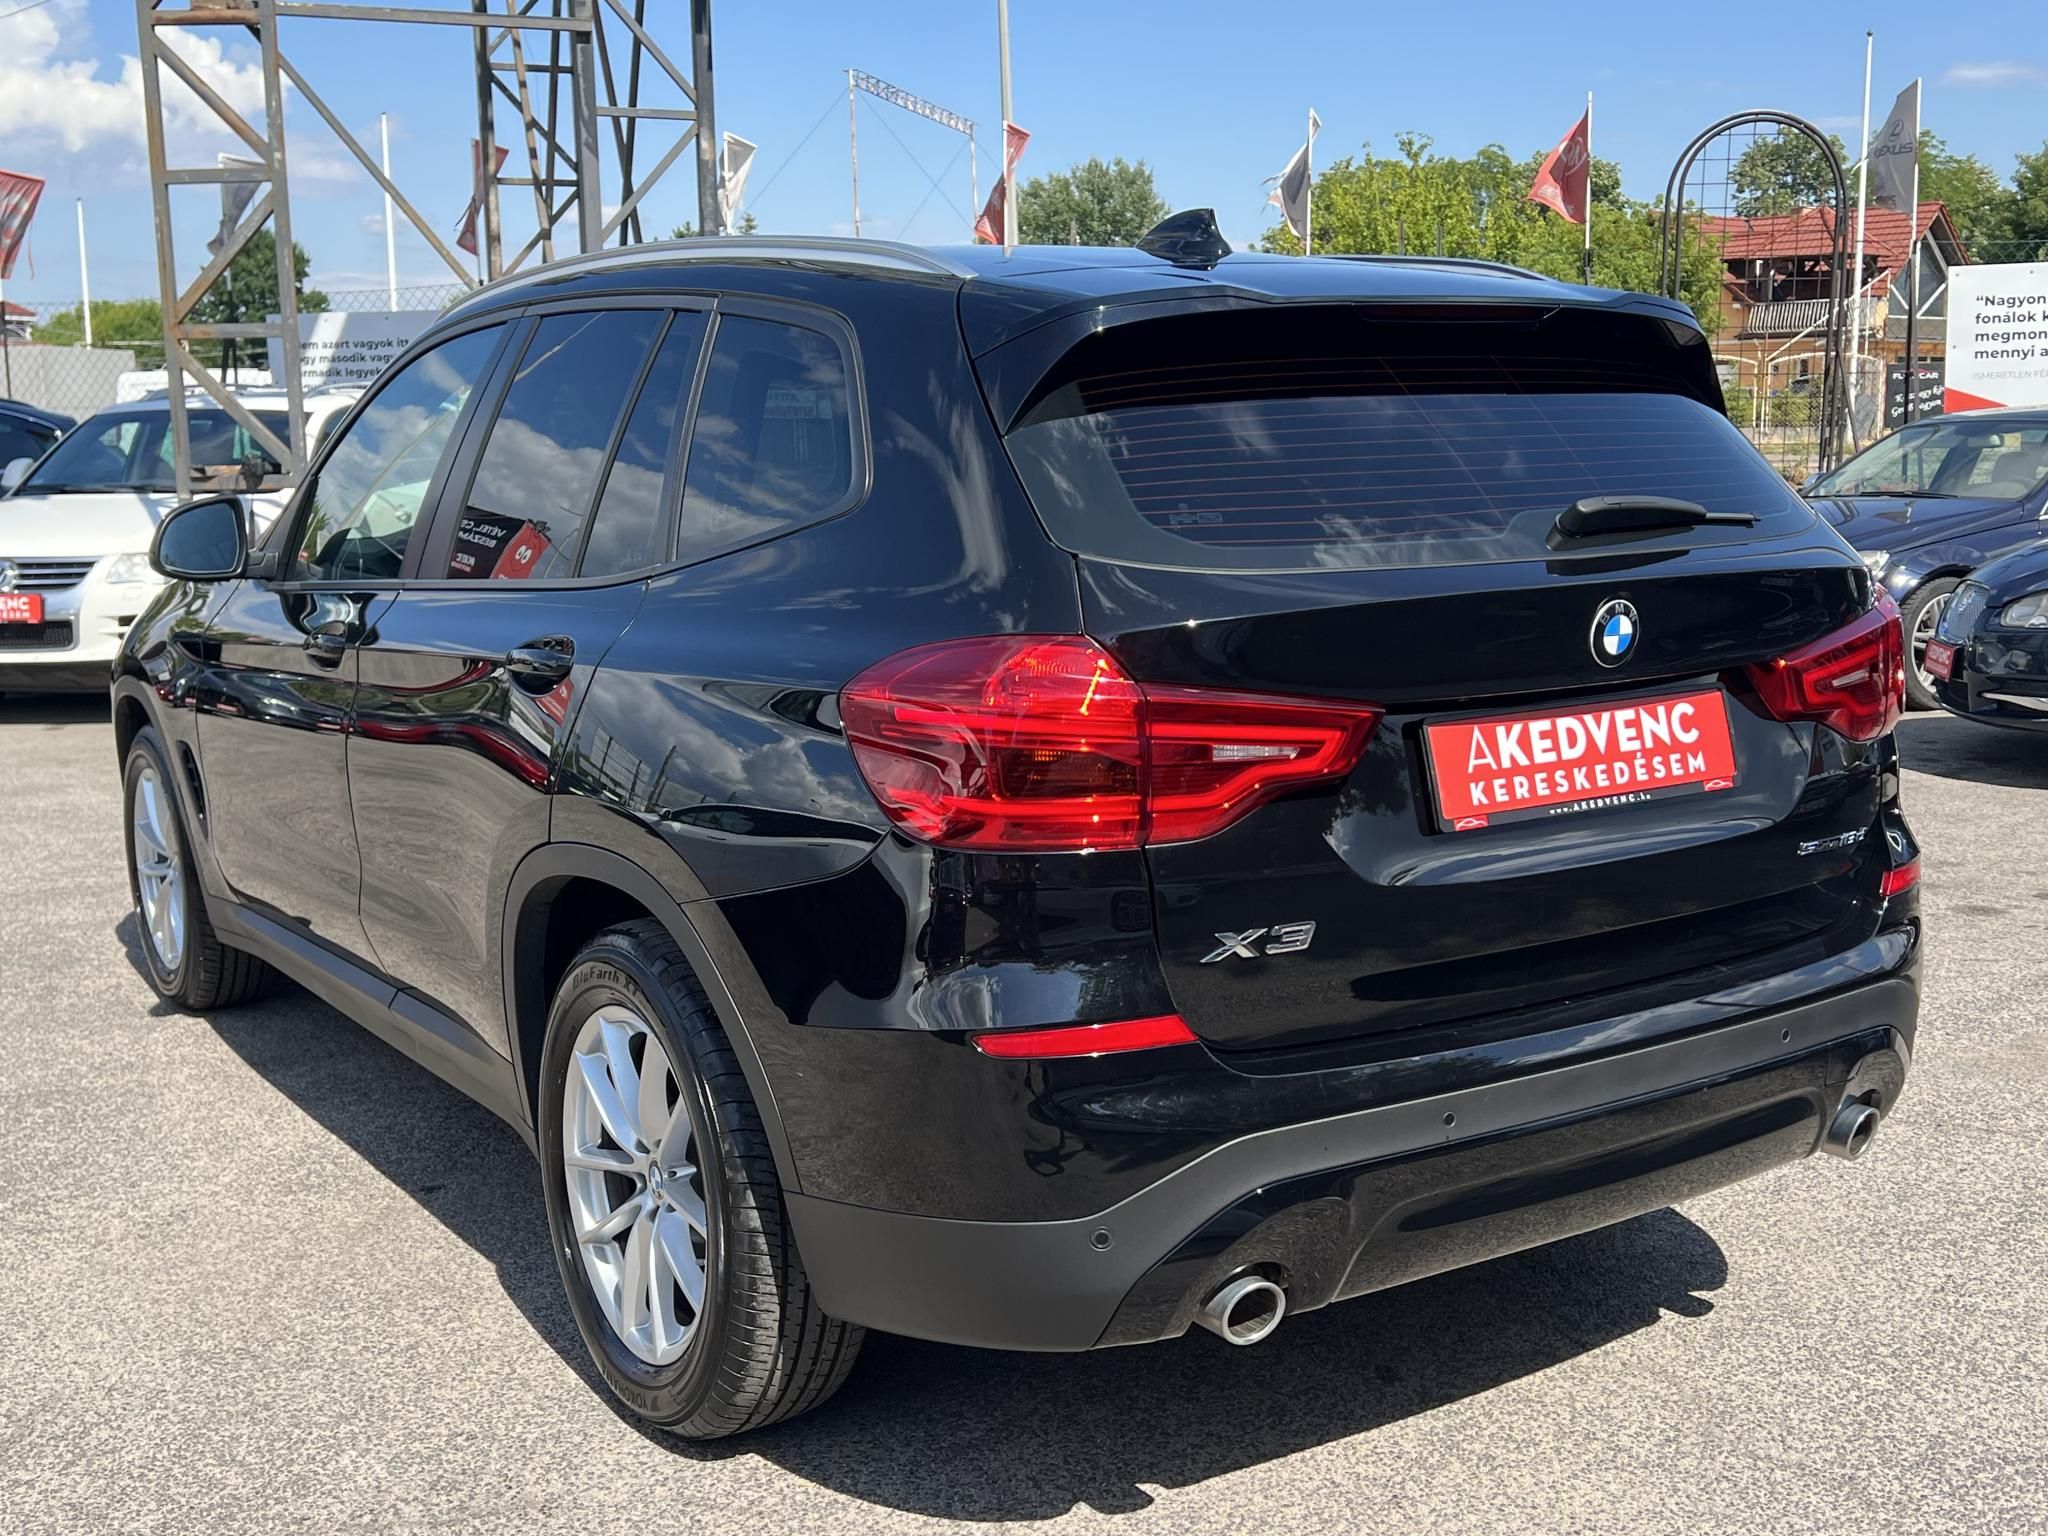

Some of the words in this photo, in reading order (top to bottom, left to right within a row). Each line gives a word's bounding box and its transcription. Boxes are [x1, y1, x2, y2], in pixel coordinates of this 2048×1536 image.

[1975, 310, 2037, 324] fonálok
[352, 338, 393, 350] vagyok
[1974, 345, 2035, 360] mennyi
[1600, 602, 1638, 626] BMW
[1468, 750, 1707, 807] KERESKEDÉSEM
[1199, 920, 1317, 964] X3
